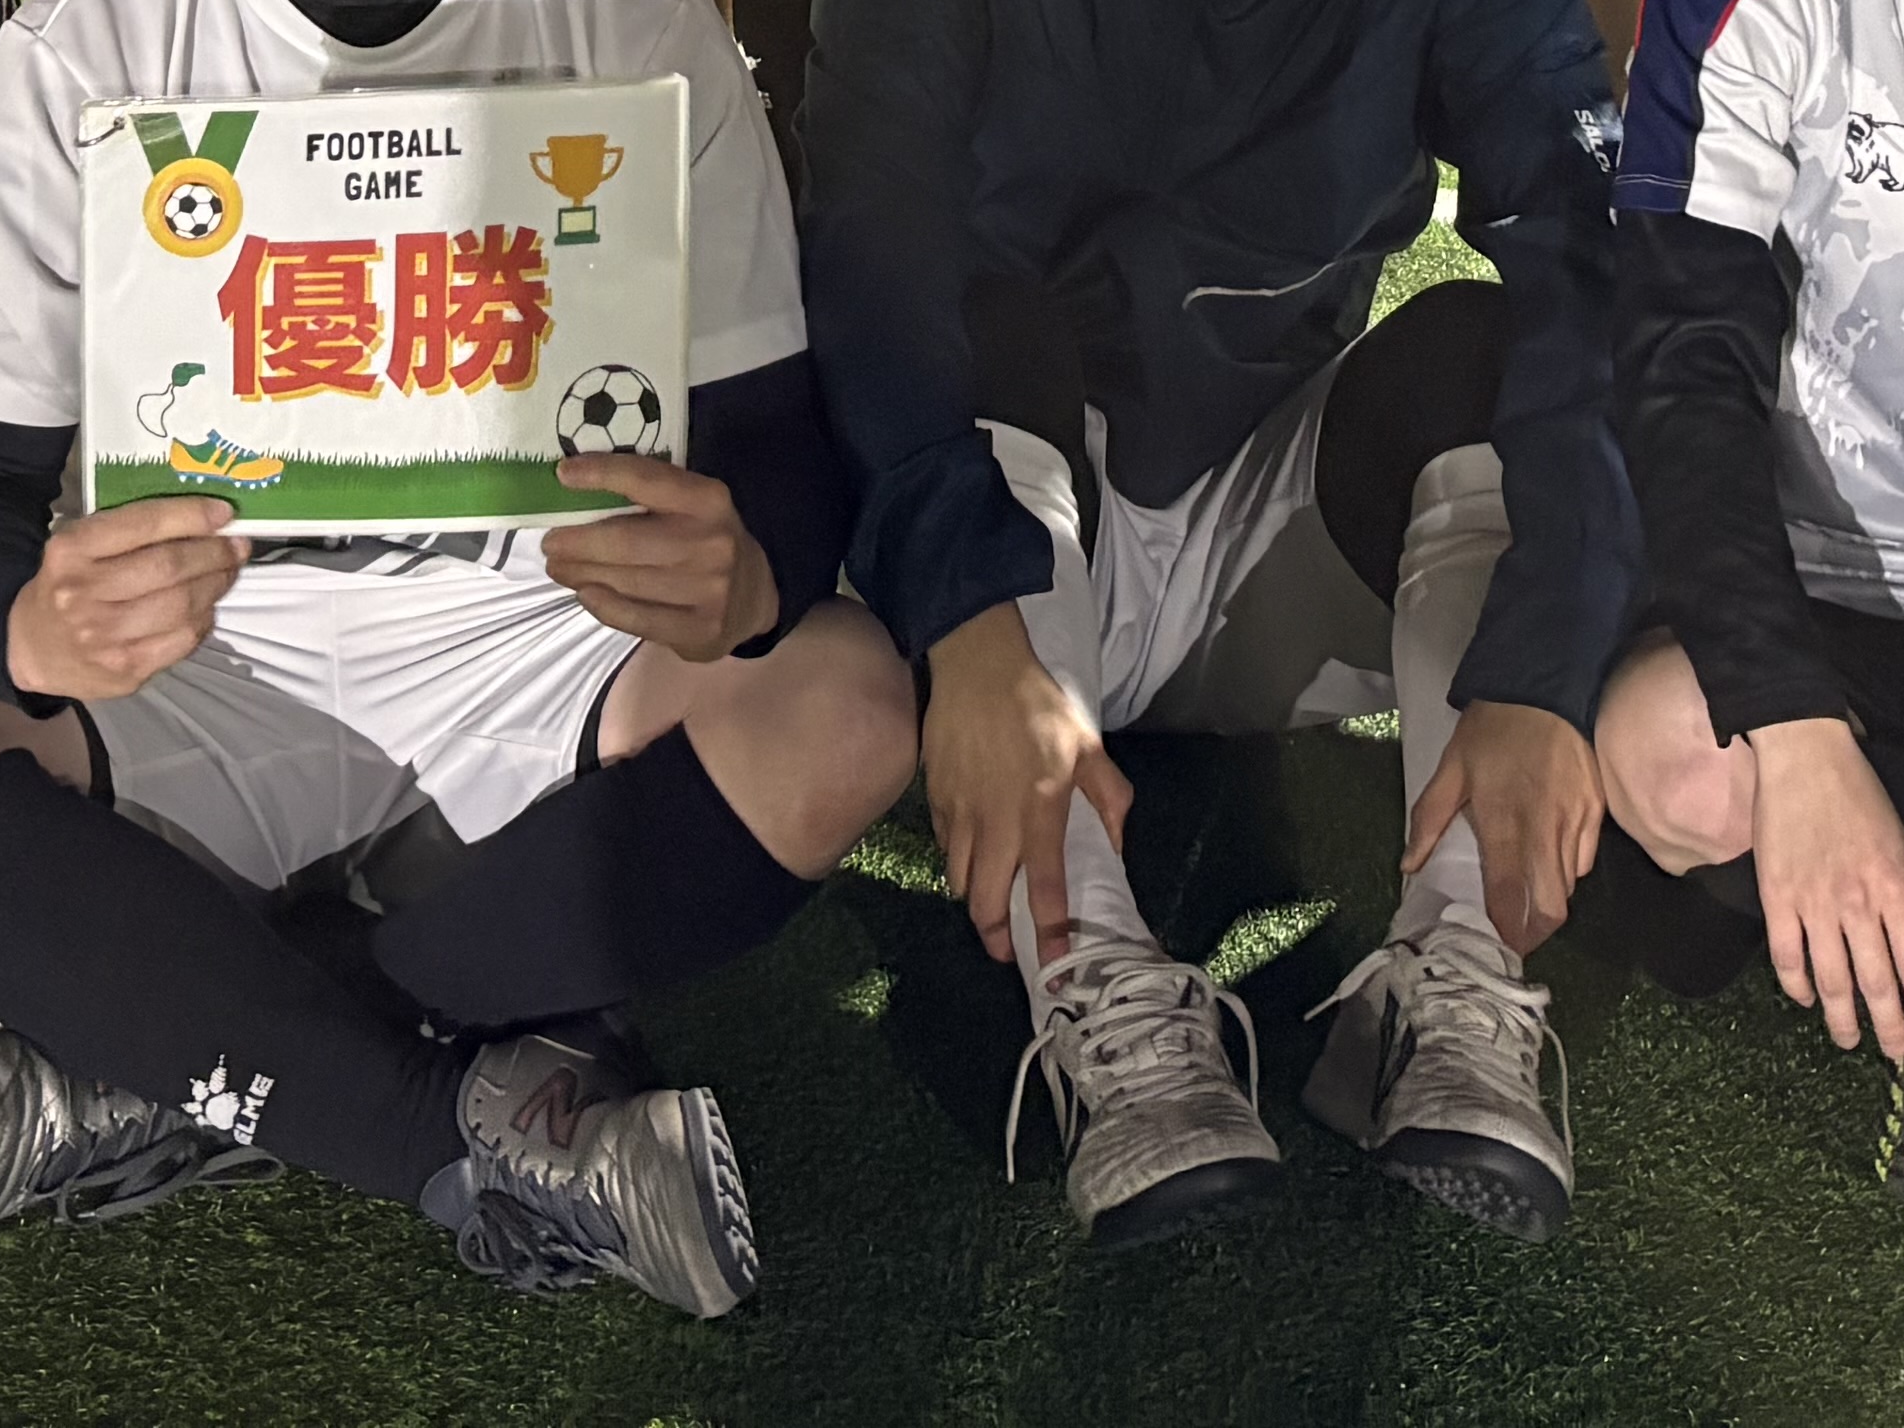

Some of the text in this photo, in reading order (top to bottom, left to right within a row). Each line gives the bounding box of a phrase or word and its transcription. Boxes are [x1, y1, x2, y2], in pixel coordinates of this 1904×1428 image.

[305, 127, 462, 162] FOOTBALL
[345, 170, 423, 201] GAME
[217, 223, 552, 402] 優勝
[233, 1072, 275, 1145] ELME
